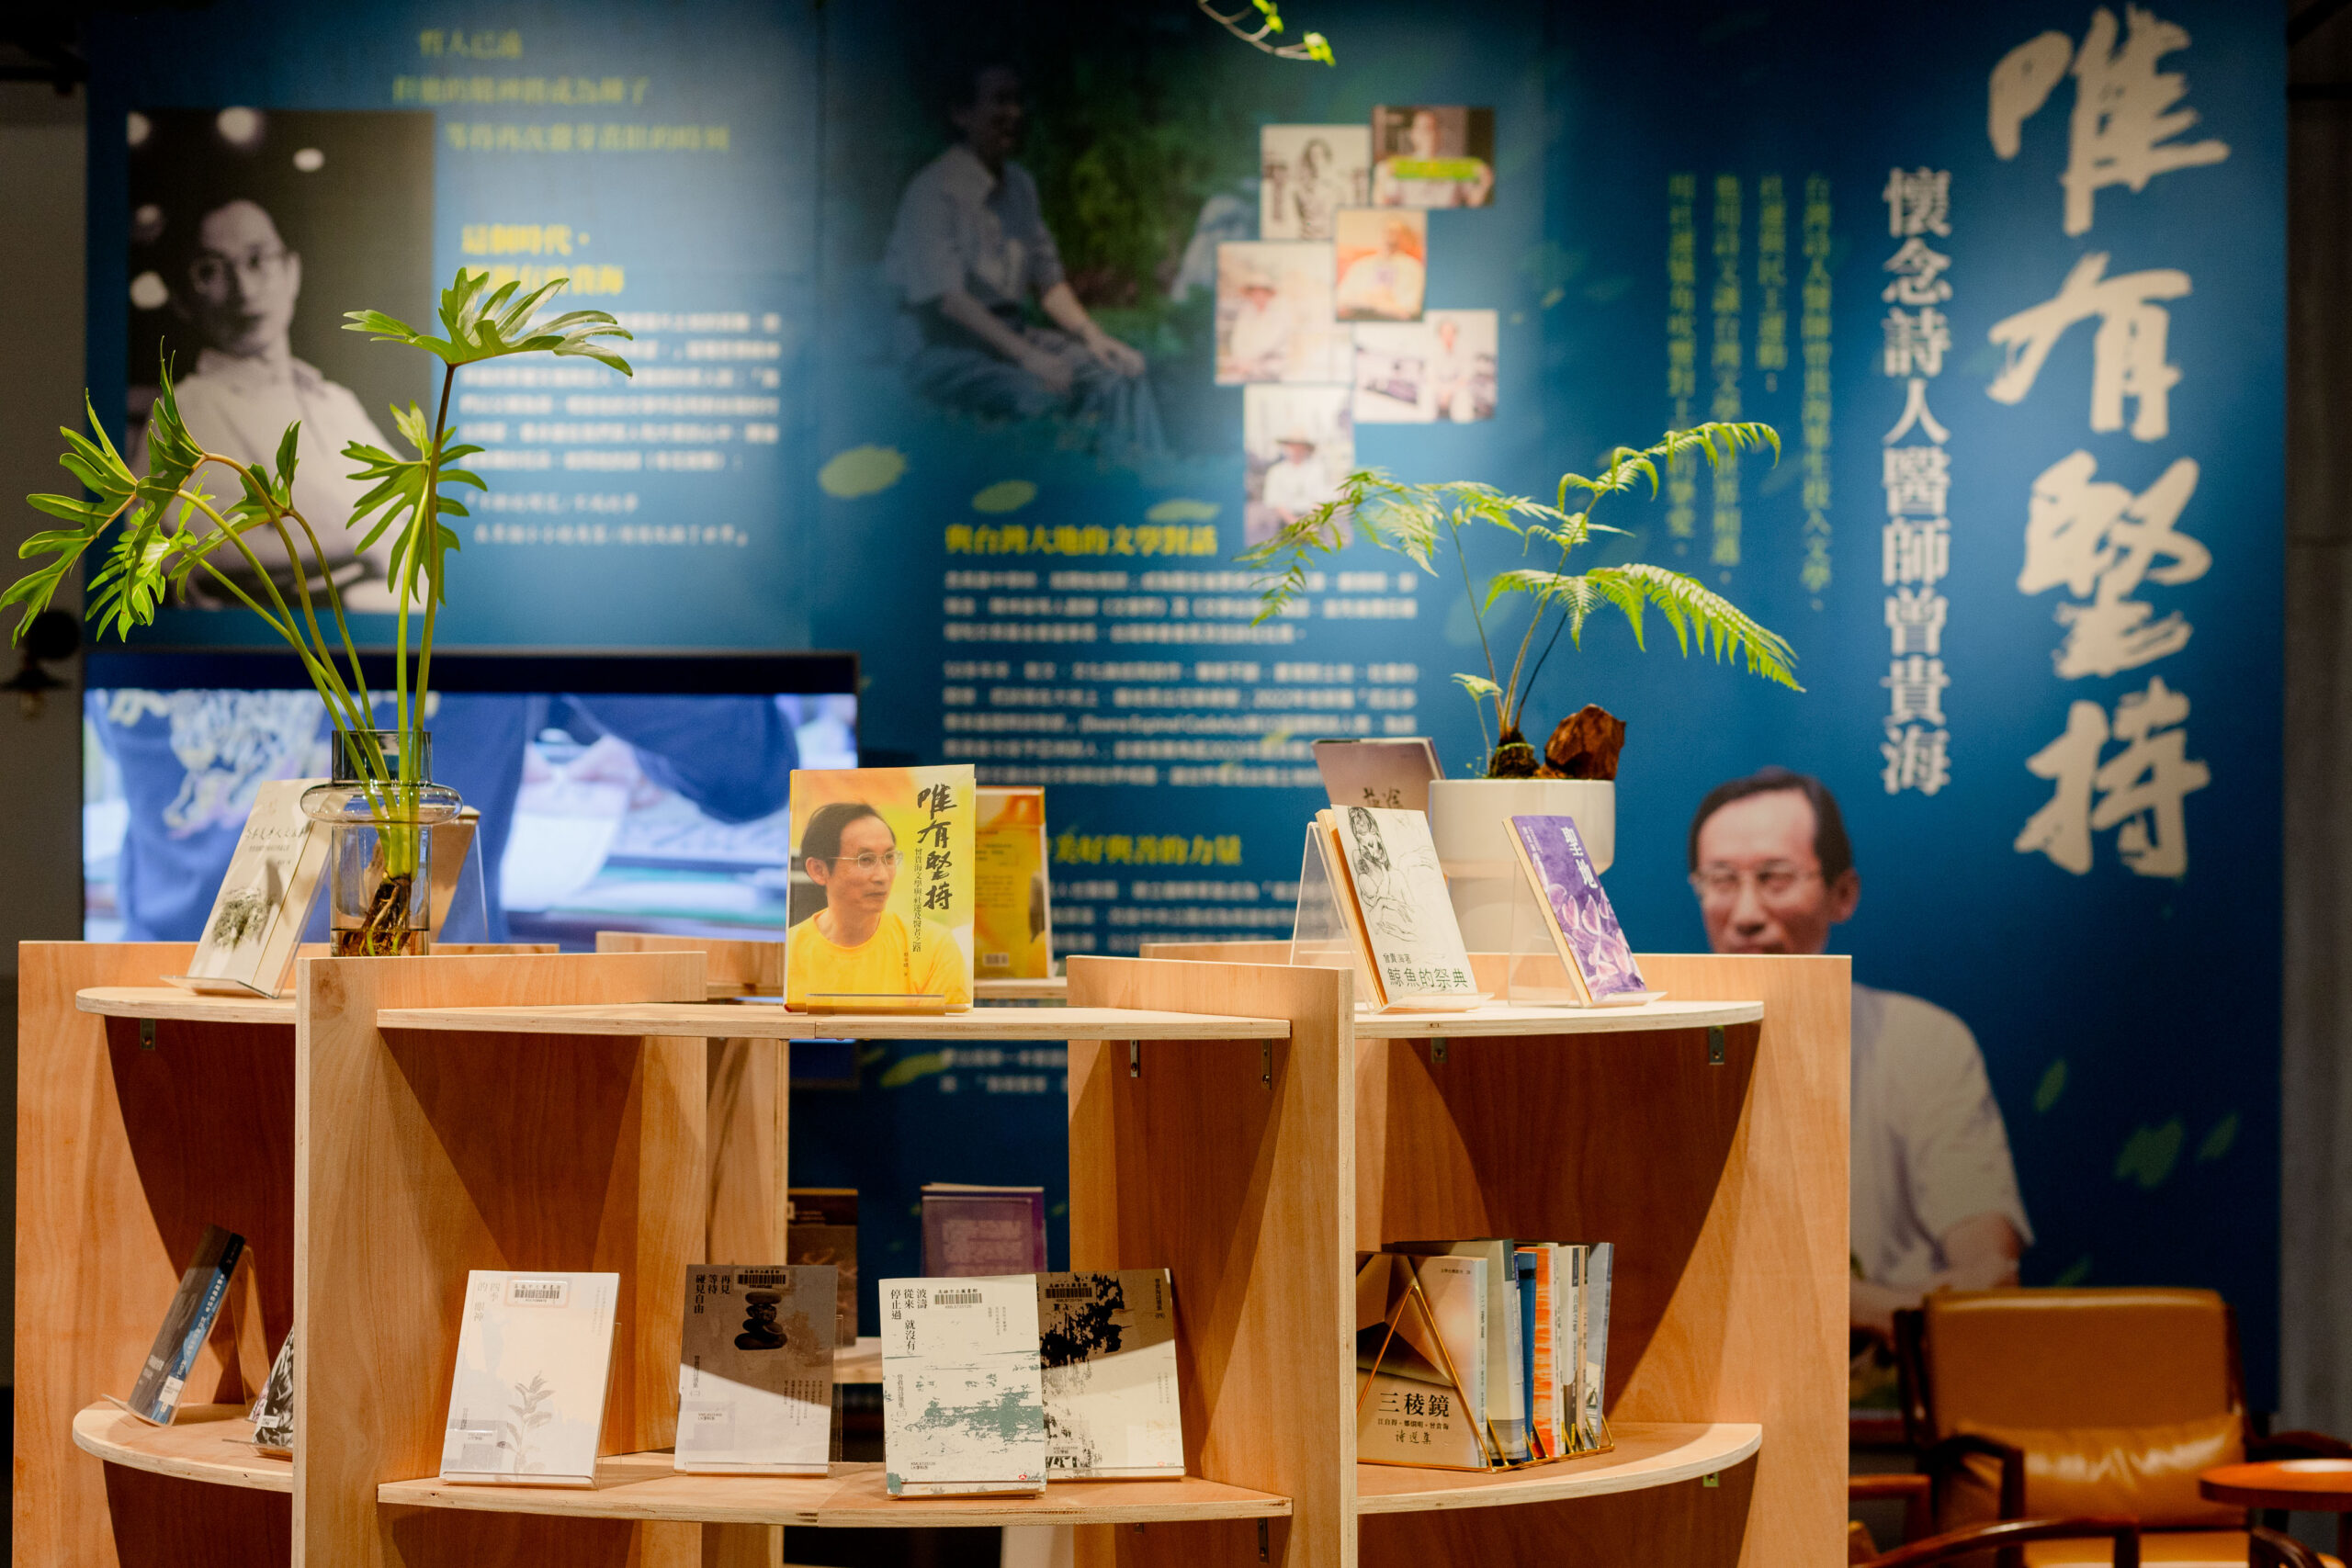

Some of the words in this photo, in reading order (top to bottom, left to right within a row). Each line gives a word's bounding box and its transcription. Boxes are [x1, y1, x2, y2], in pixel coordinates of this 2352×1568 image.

[1882, 167, 1952, 797] 懷念詩人醫師曾貴海
[917, 783, 957, 910] 唯有堅持
[1046, 834, 1243, 866] 美好與善的力量
[1387, 966, 1469, 989] 鯨魚的祭典
[694, 1274, 706, 1314] 碰見自由
[708, 1274, 718, 1294] 等待
[721, 1274, 730, 1294] 再見
[890, 1289, 901, 1320] 停止過
[904, 1288, 915, 1309] 從來
[917, 1288, 927, 1309] 波濤
[905, 1319, 916, 1351] 就沒有
[1378, 1392, 1450, 1417] 三稜鏡
